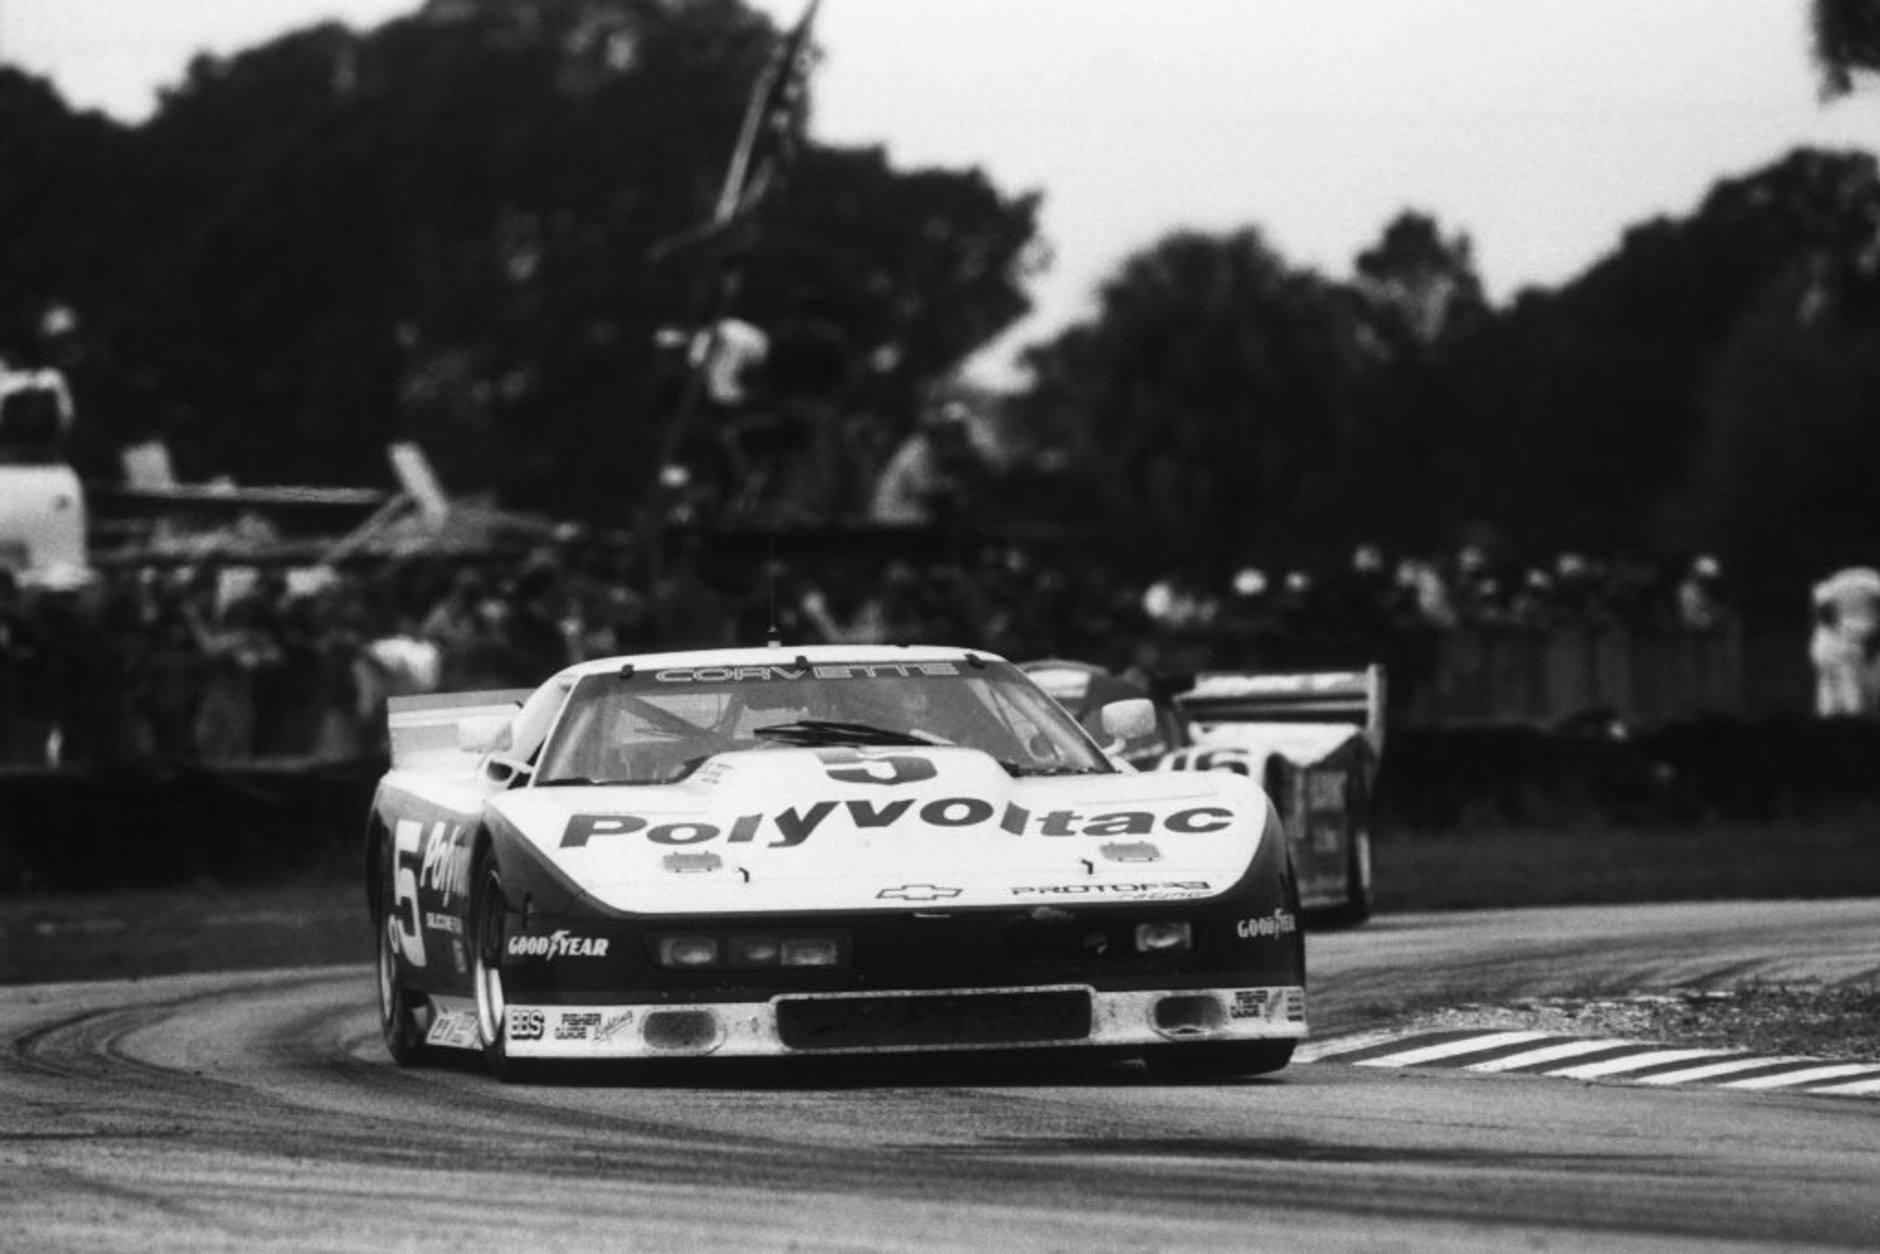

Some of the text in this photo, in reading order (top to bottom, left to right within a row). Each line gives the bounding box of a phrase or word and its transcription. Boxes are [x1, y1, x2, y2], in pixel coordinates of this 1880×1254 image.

[655, 661, 960, 683] CORVETTE
[814, 750, 938, 785] 5
[560, 797, 1234, 848] Polyvoltac
[393, 818, 427, 967] 5
[508, 930, 609, 961] GOODYEAR
[510, 1008, 545, 1041] BBS
